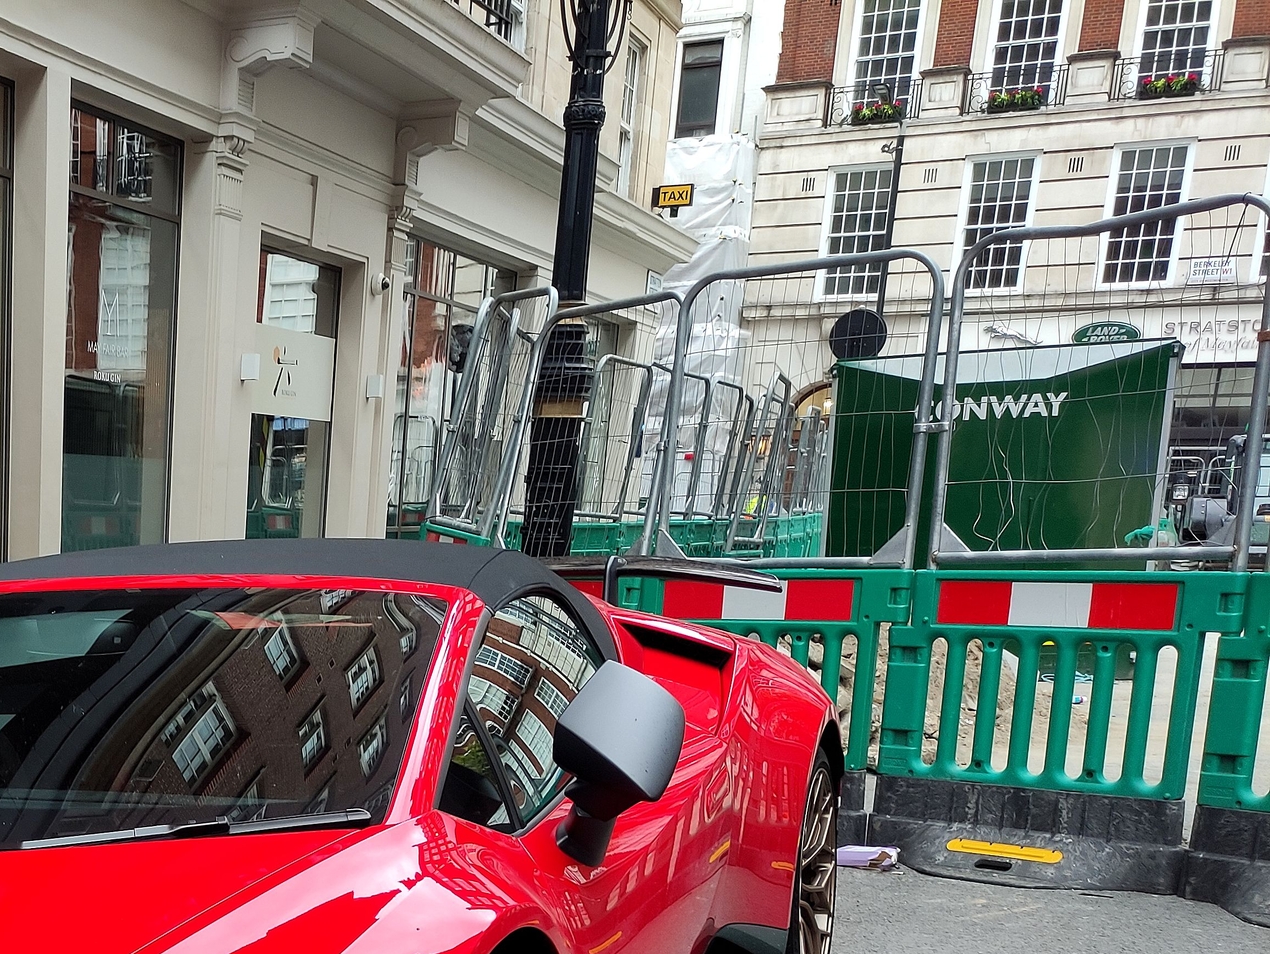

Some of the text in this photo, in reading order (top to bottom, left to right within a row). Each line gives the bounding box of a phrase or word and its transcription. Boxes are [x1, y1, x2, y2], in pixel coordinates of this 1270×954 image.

[661, 190, 689, 201] TAXI
[1193, 260, 1231, 268] BERKELEY
[1192, 268, 1219, 276] STREET
[1086, 326, 1119, 336] LAND
[1200, 336, 1258, 354] Mayfai
[93, 370, 121, 383] ROKU GIN
